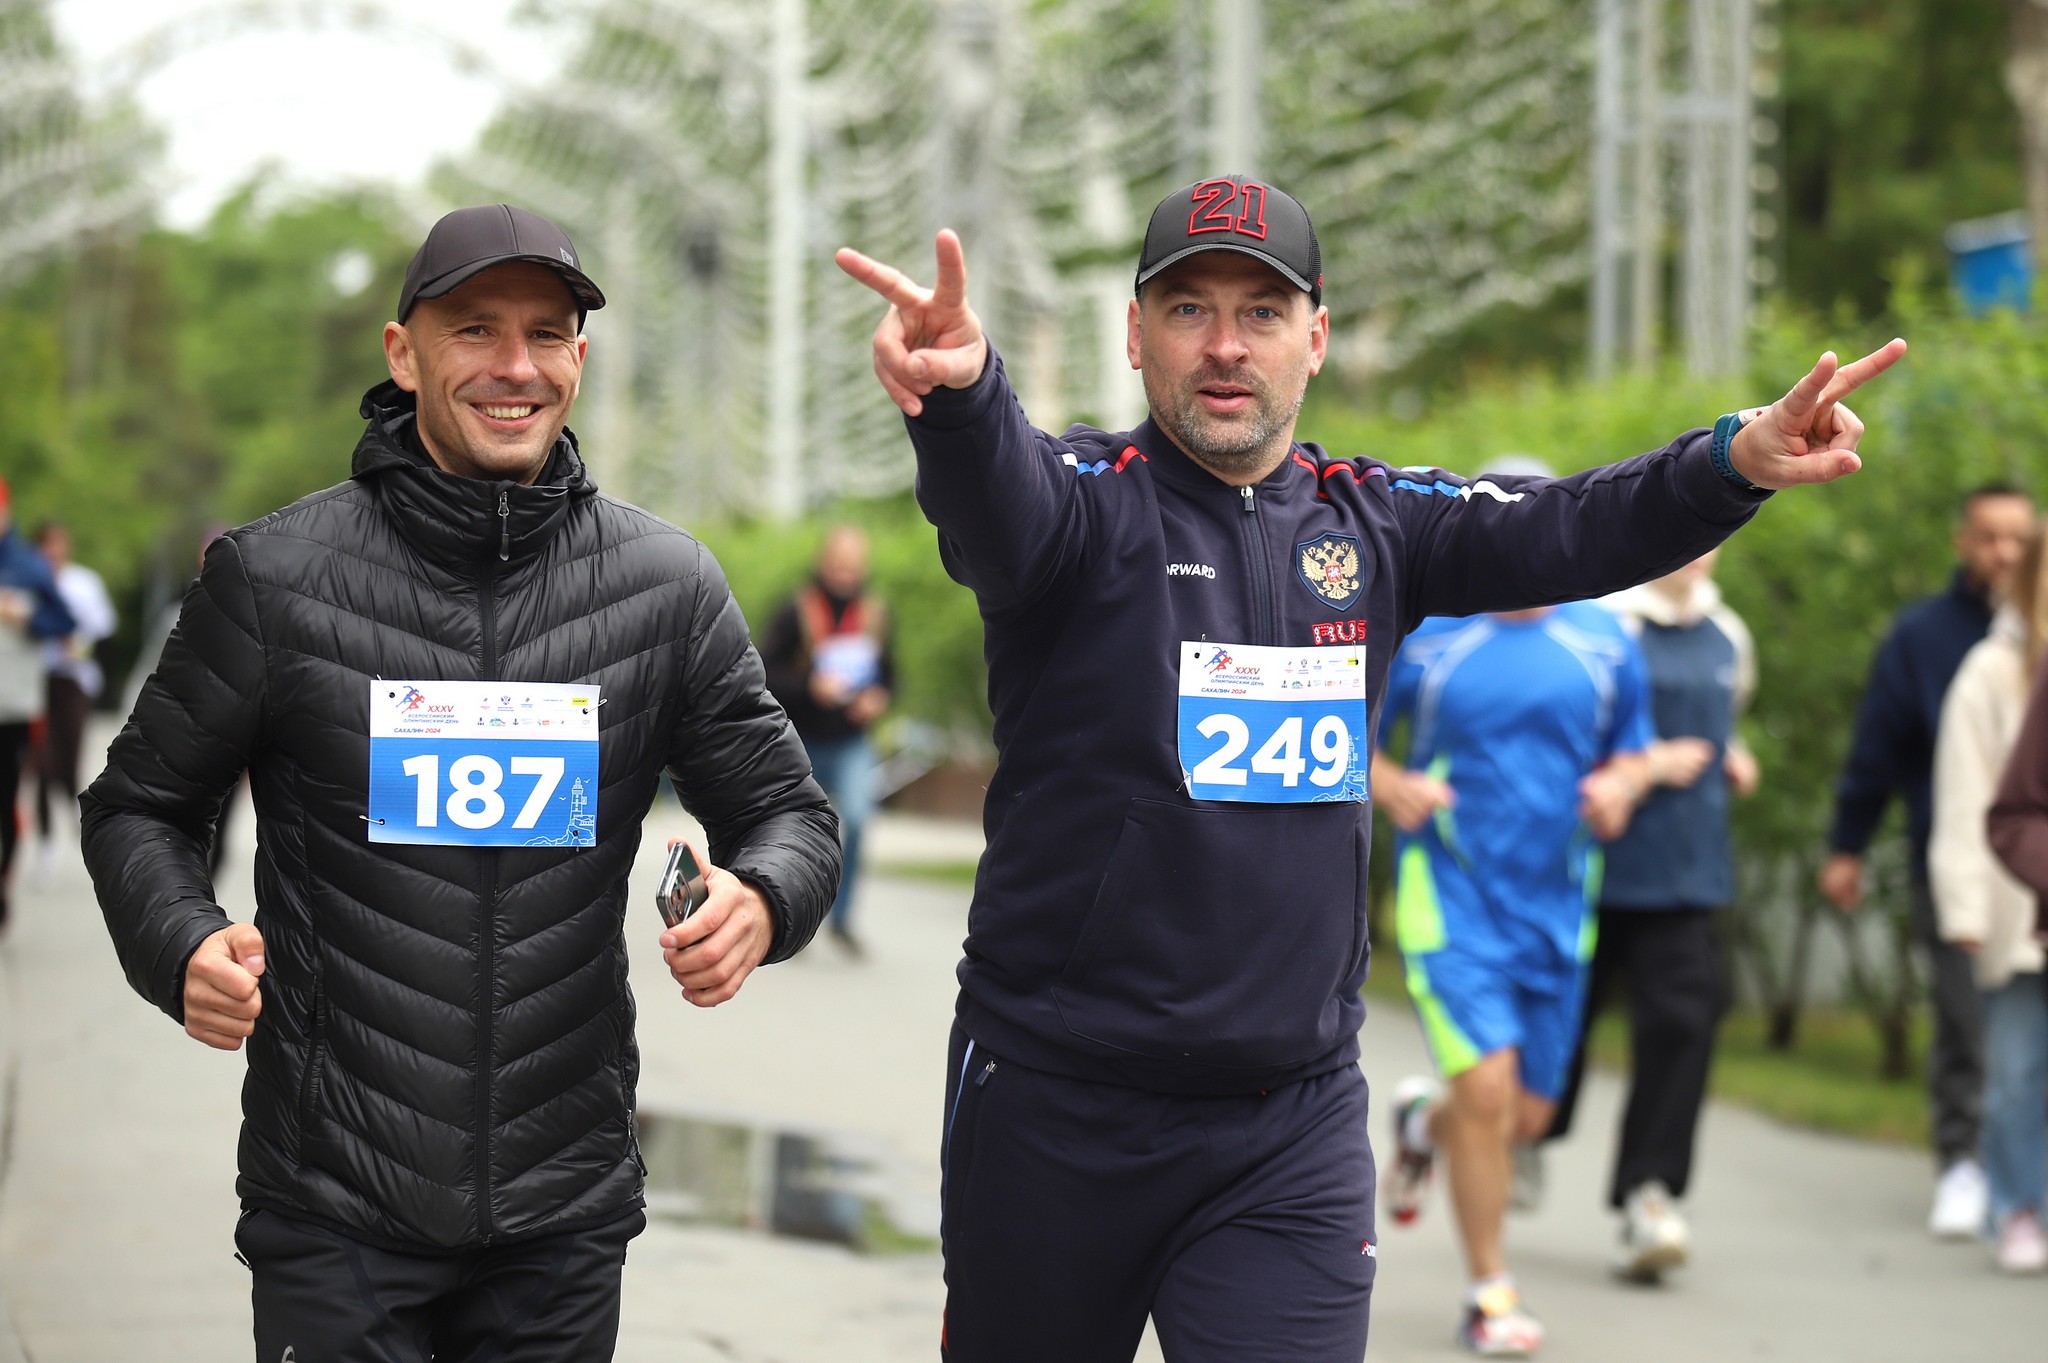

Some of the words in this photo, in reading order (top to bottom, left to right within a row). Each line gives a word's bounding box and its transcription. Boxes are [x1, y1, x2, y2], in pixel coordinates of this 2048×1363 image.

[1188, 179, 1268, 240] 21
[1166, 563, 1216, 579] RWARD
[1234, 666, 1261, 675] XXXV
[427, 705, 455, 713] XXXV
[1193, 713, 1350, 788] 249
[402, 754, 565, 830] 187
